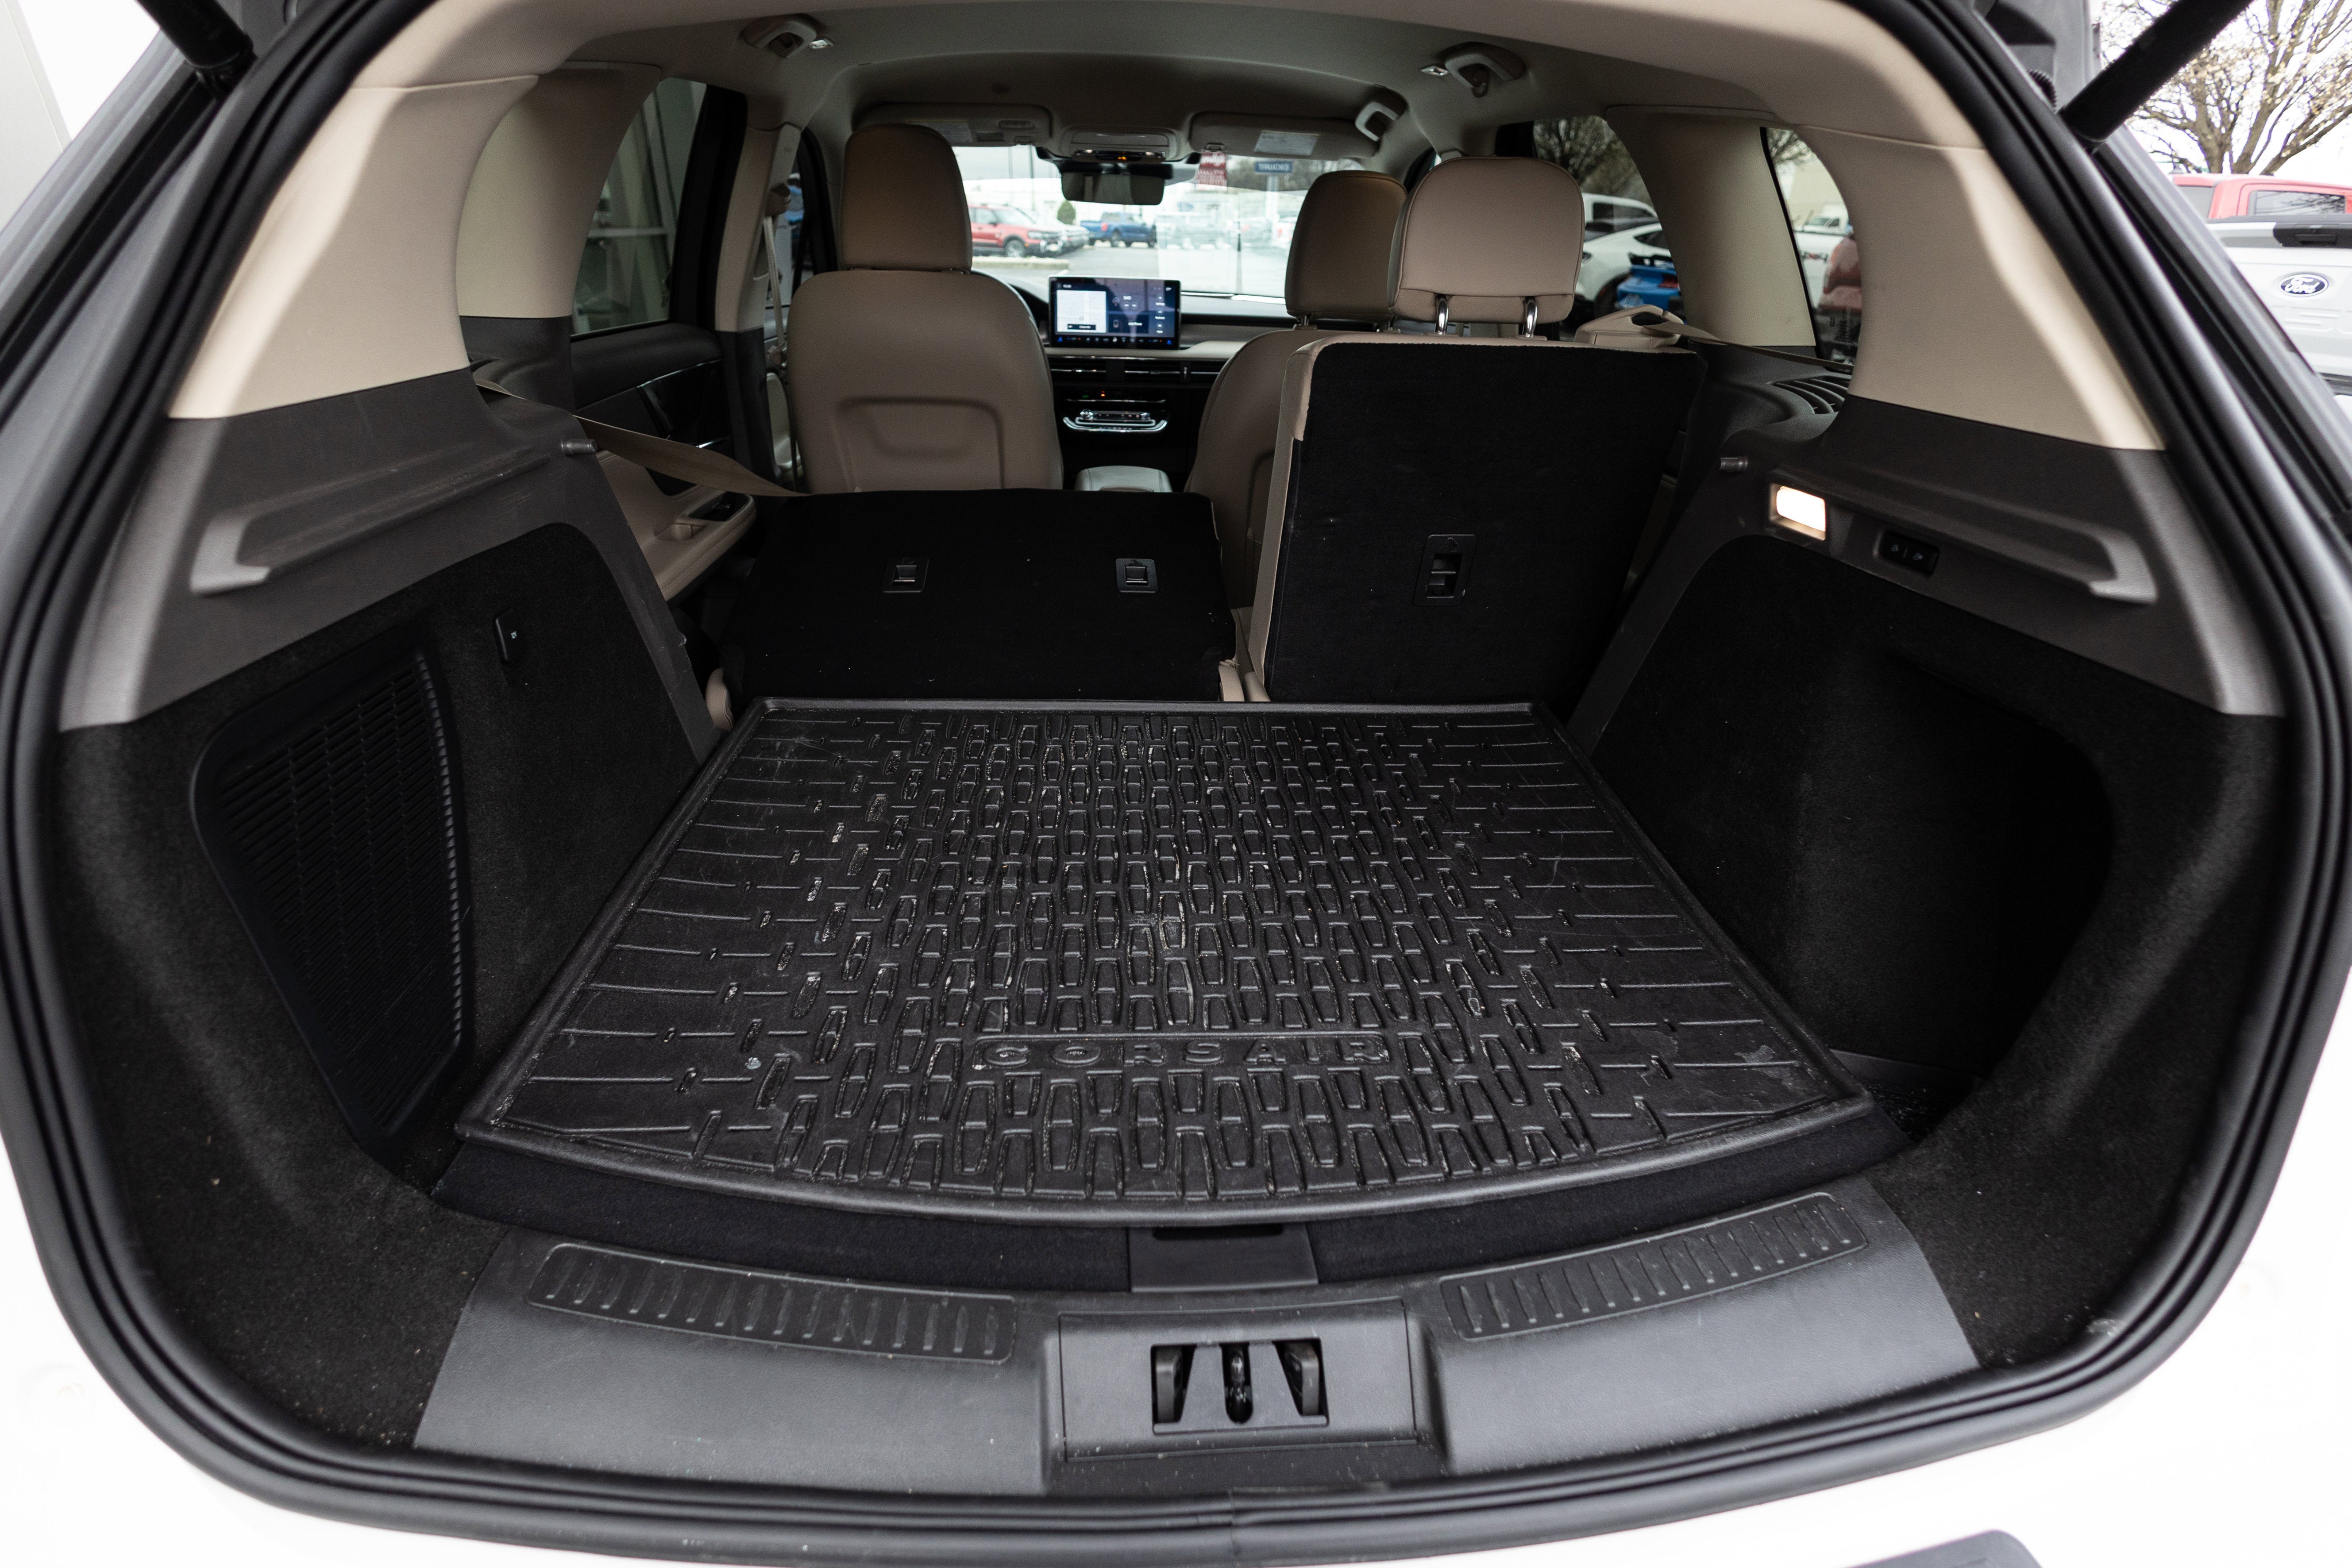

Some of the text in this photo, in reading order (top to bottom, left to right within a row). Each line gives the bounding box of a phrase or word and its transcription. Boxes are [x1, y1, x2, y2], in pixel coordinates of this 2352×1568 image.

[1257, 162, 1290, 172] TRUCKS
[2284, 277, 2320, 294] Ford
[983, 1039, 1387, 1067] CORSAIR
